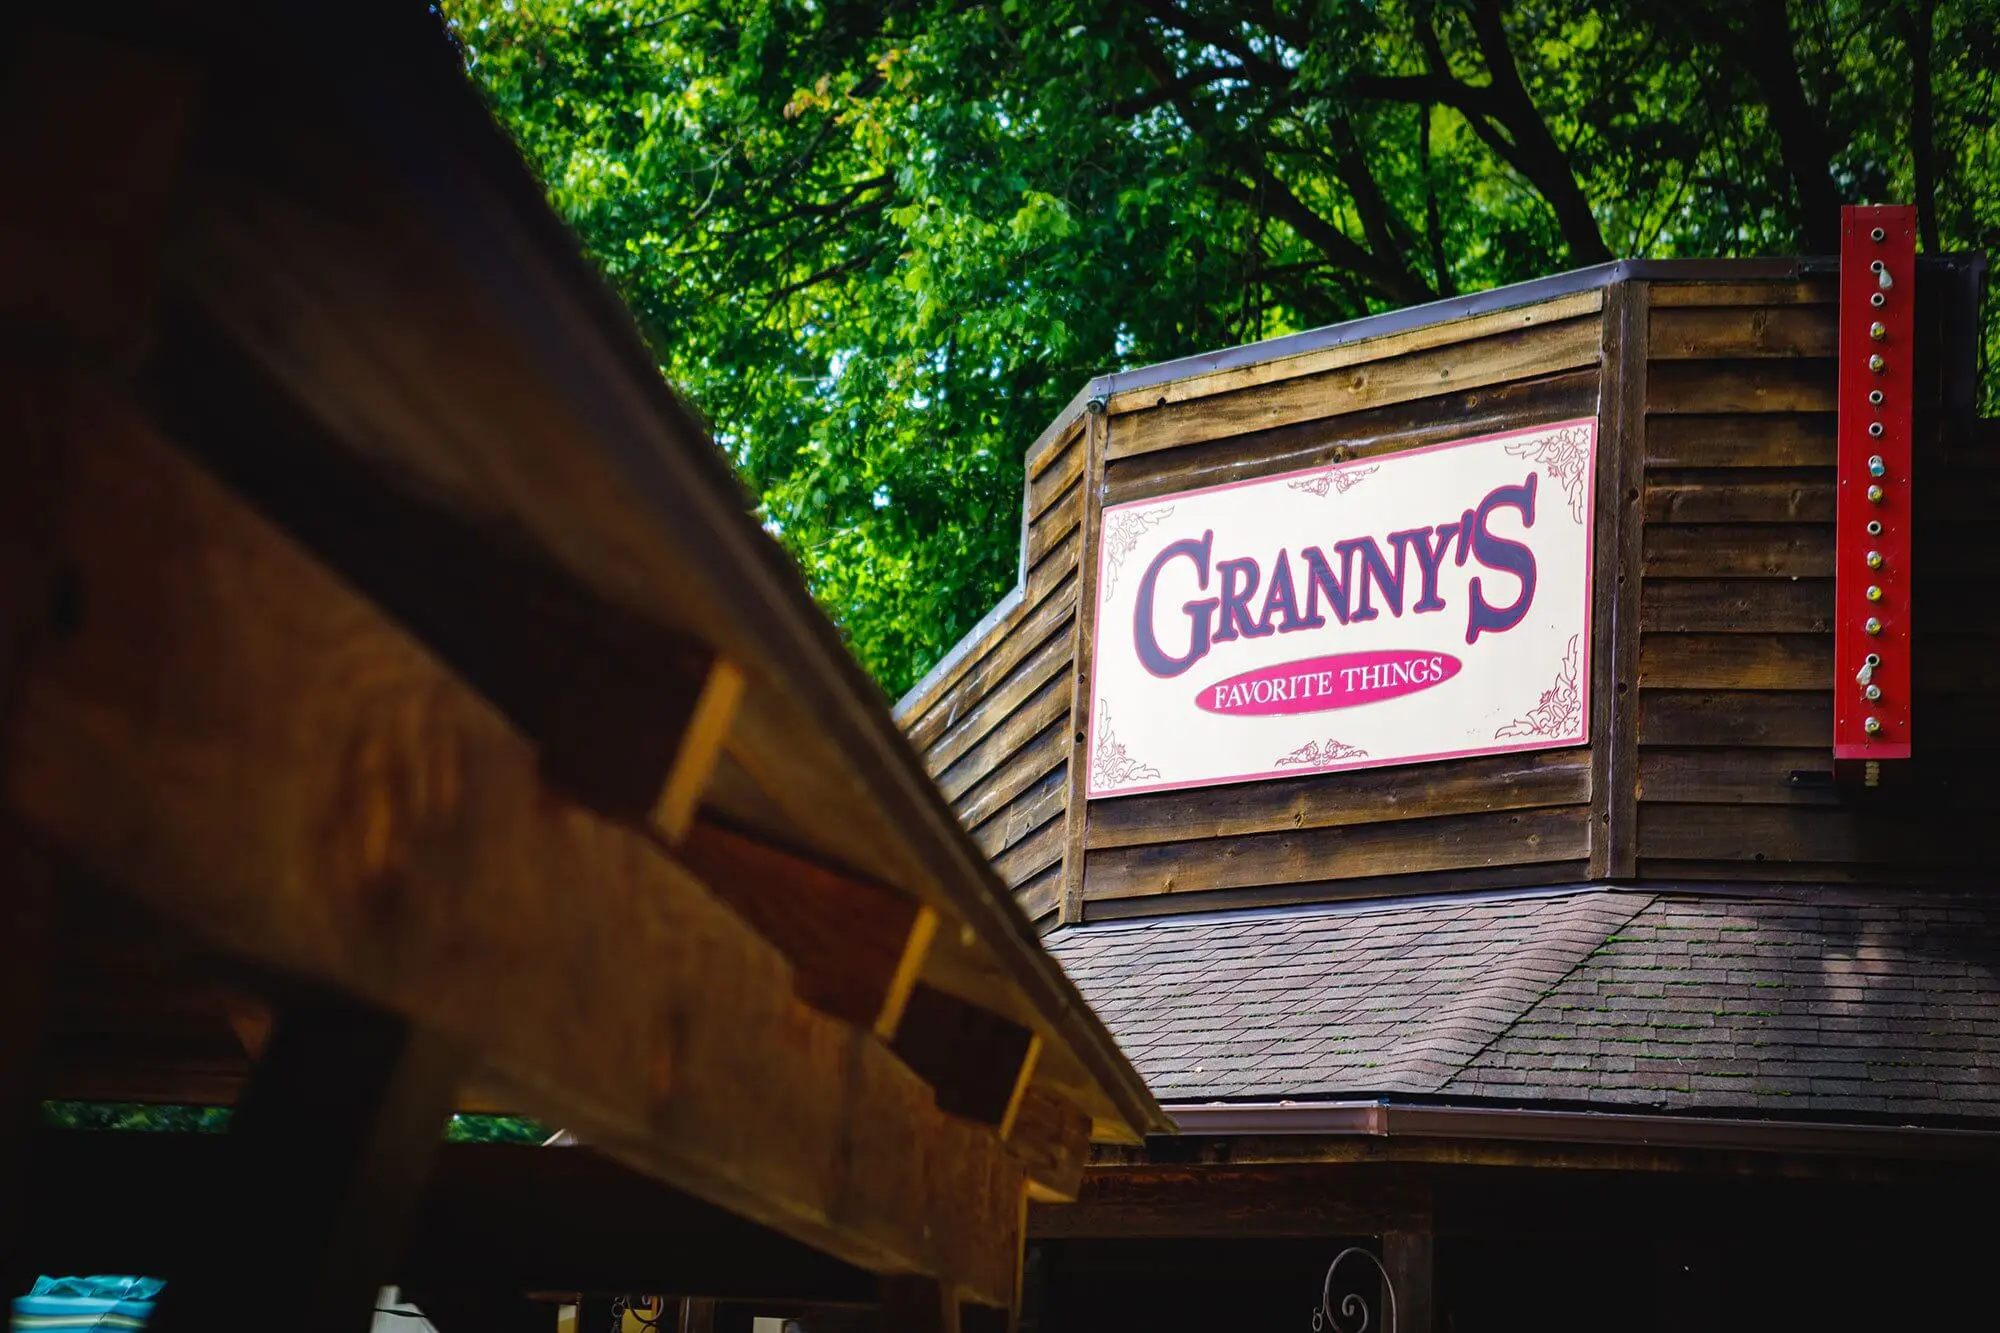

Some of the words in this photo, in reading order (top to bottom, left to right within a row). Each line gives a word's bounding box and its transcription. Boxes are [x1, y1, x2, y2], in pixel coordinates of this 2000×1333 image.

[1133, 472, 1537, 679] GRANNY'S
[1213, 669, 1333, 710] FAVORITE
[1340, 656, 1444, 693] THINGS
